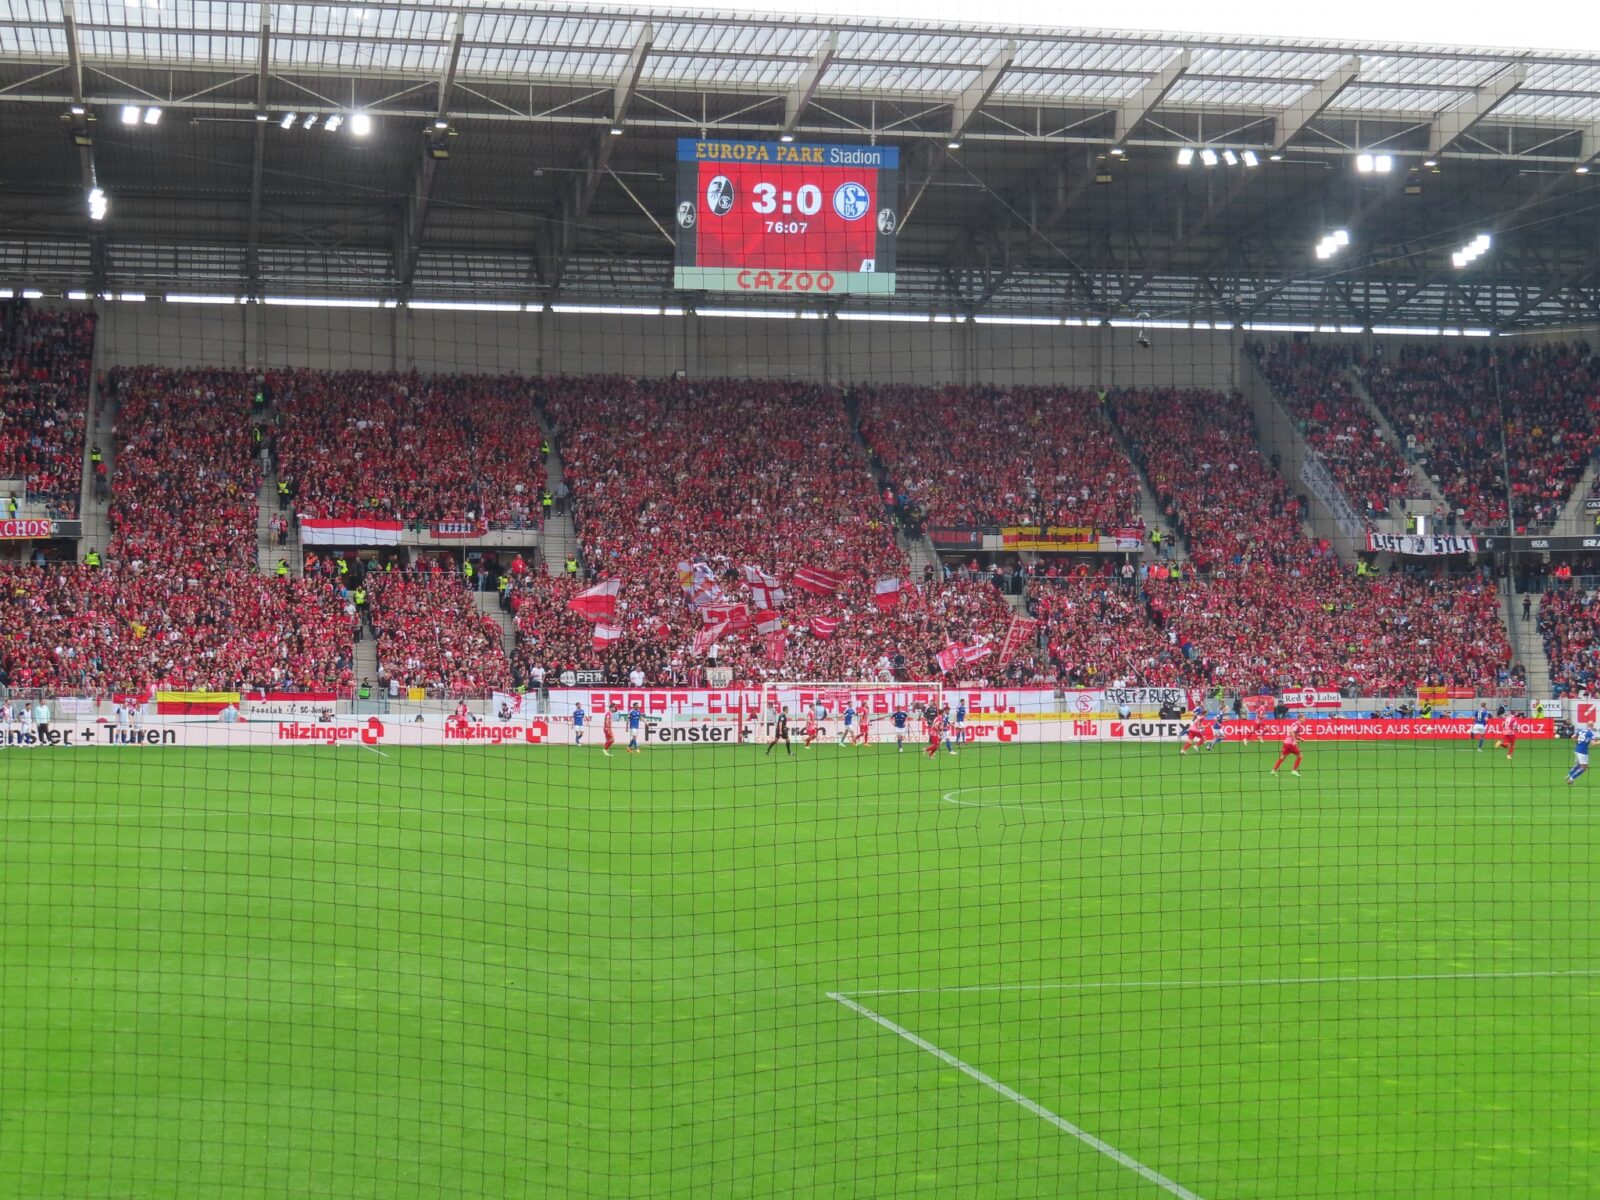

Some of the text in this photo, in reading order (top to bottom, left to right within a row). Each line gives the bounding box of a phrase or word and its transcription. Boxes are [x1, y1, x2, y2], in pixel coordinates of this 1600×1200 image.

[695, 143, 880, 165] EUROPA PARK Stadion
[751, 182, 822, 216] 3:0
[765, 221, 808, 234] 76:07
[736, 270, 835, 291] CAZOO
[0, 521, 48, 536] CHOS
[1373, 535, 1471, 553] LIST SYLT
[591, 693, 781, 714] SPORT-CLUB
[1285, 693, 1339, 703] Red Label
[251, 706, 282, 714] Fanclub
[279, 722, 358, 744] hilzinger
[645, 723, 732, 742] Fenster
[1128, 723, 1191, 737] GUTEX
[1316, 722, 1382, 735] DÄMMUNG
[1386, 724, 1410, 734] AUS
[1414, 724, 1545, 734] SCHWARZALHOLZ
